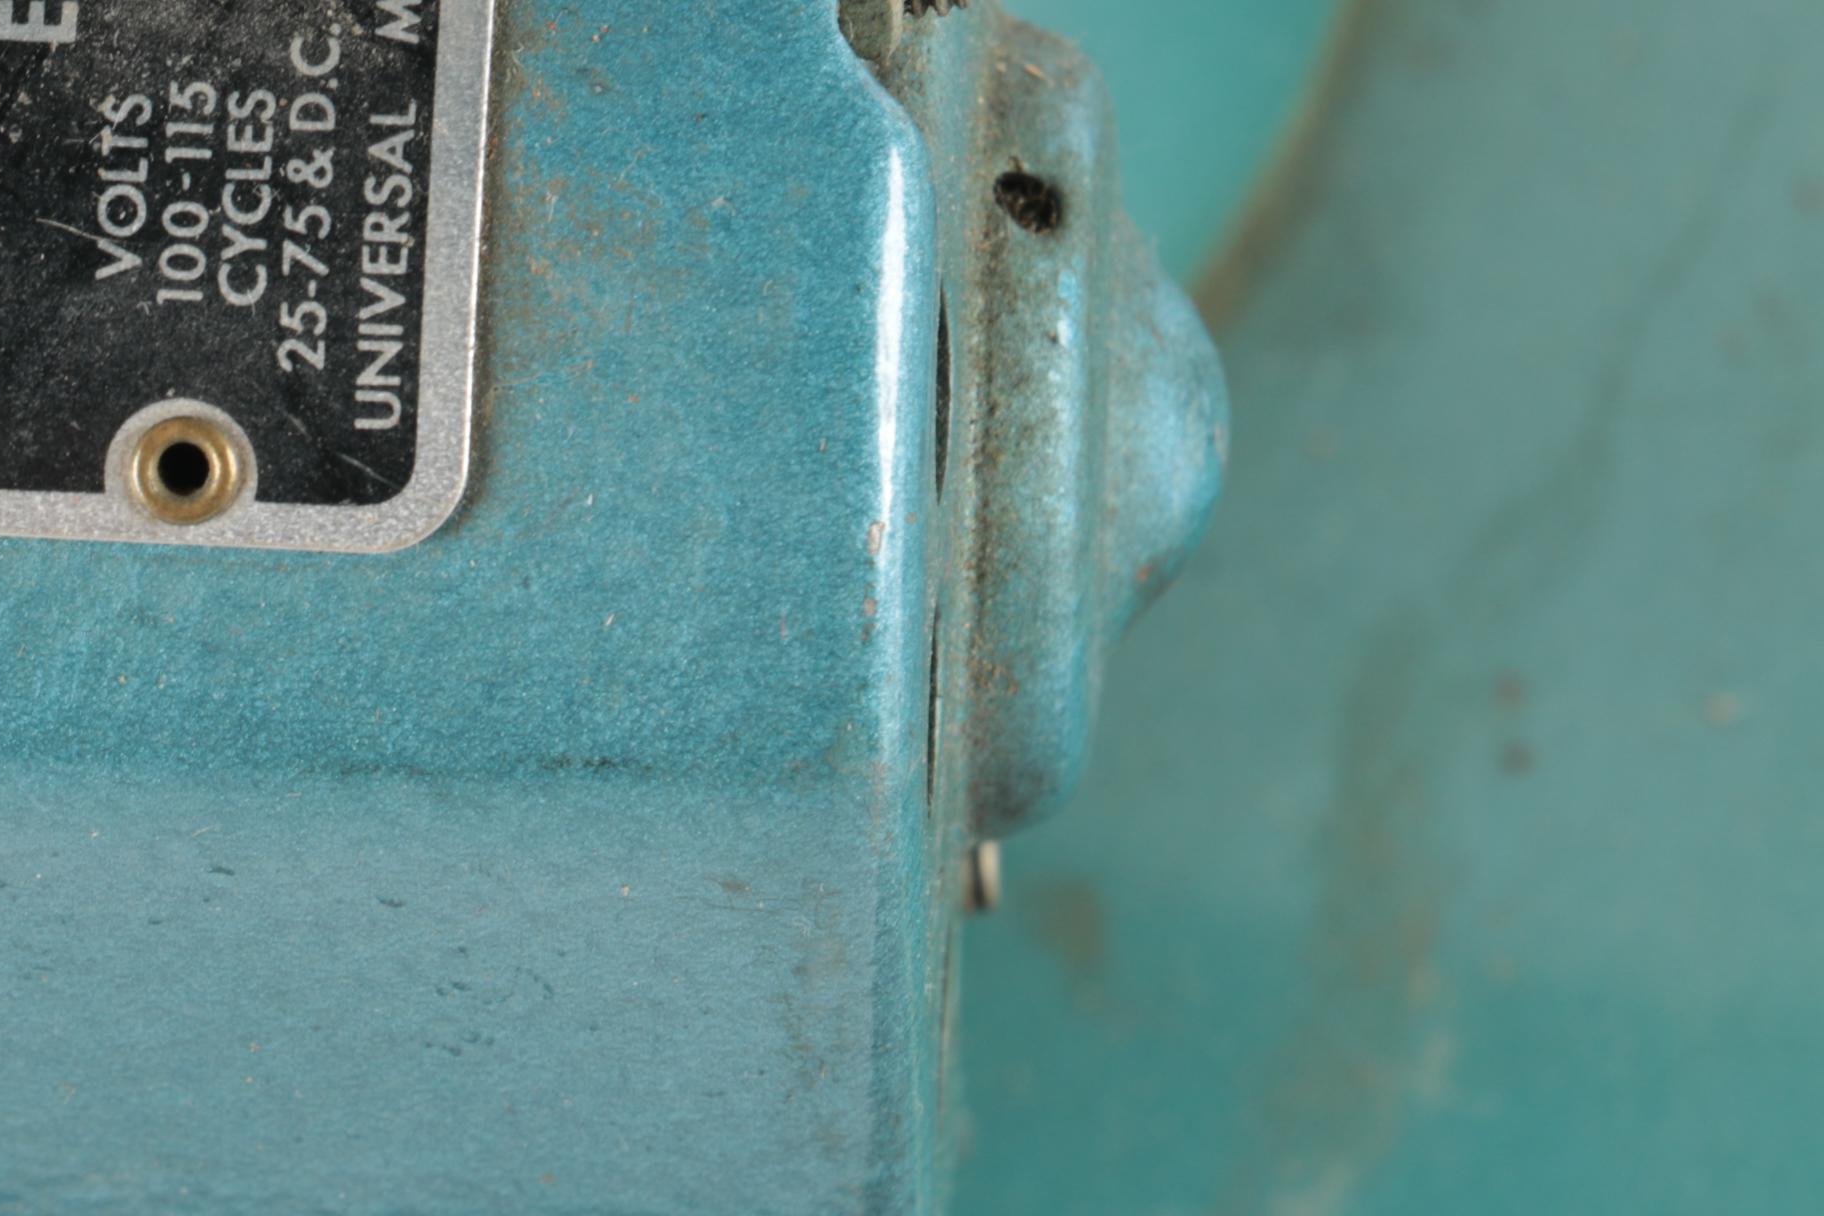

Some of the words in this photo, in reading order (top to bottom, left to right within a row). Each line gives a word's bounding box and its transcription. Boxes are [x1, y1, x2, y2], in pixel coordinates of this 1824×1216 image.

[286, 147, 335, 189] &
[289, 22, 342, 132] D.C.
[95, 94, 153, 280] VOLTS
[157, 81, 217, 304] 100-115
[218, 88, 276, 306] CYCLES
[354, 99, 417, 430] UNIVERSAL
[277, 205, 332, 373] 25-75
